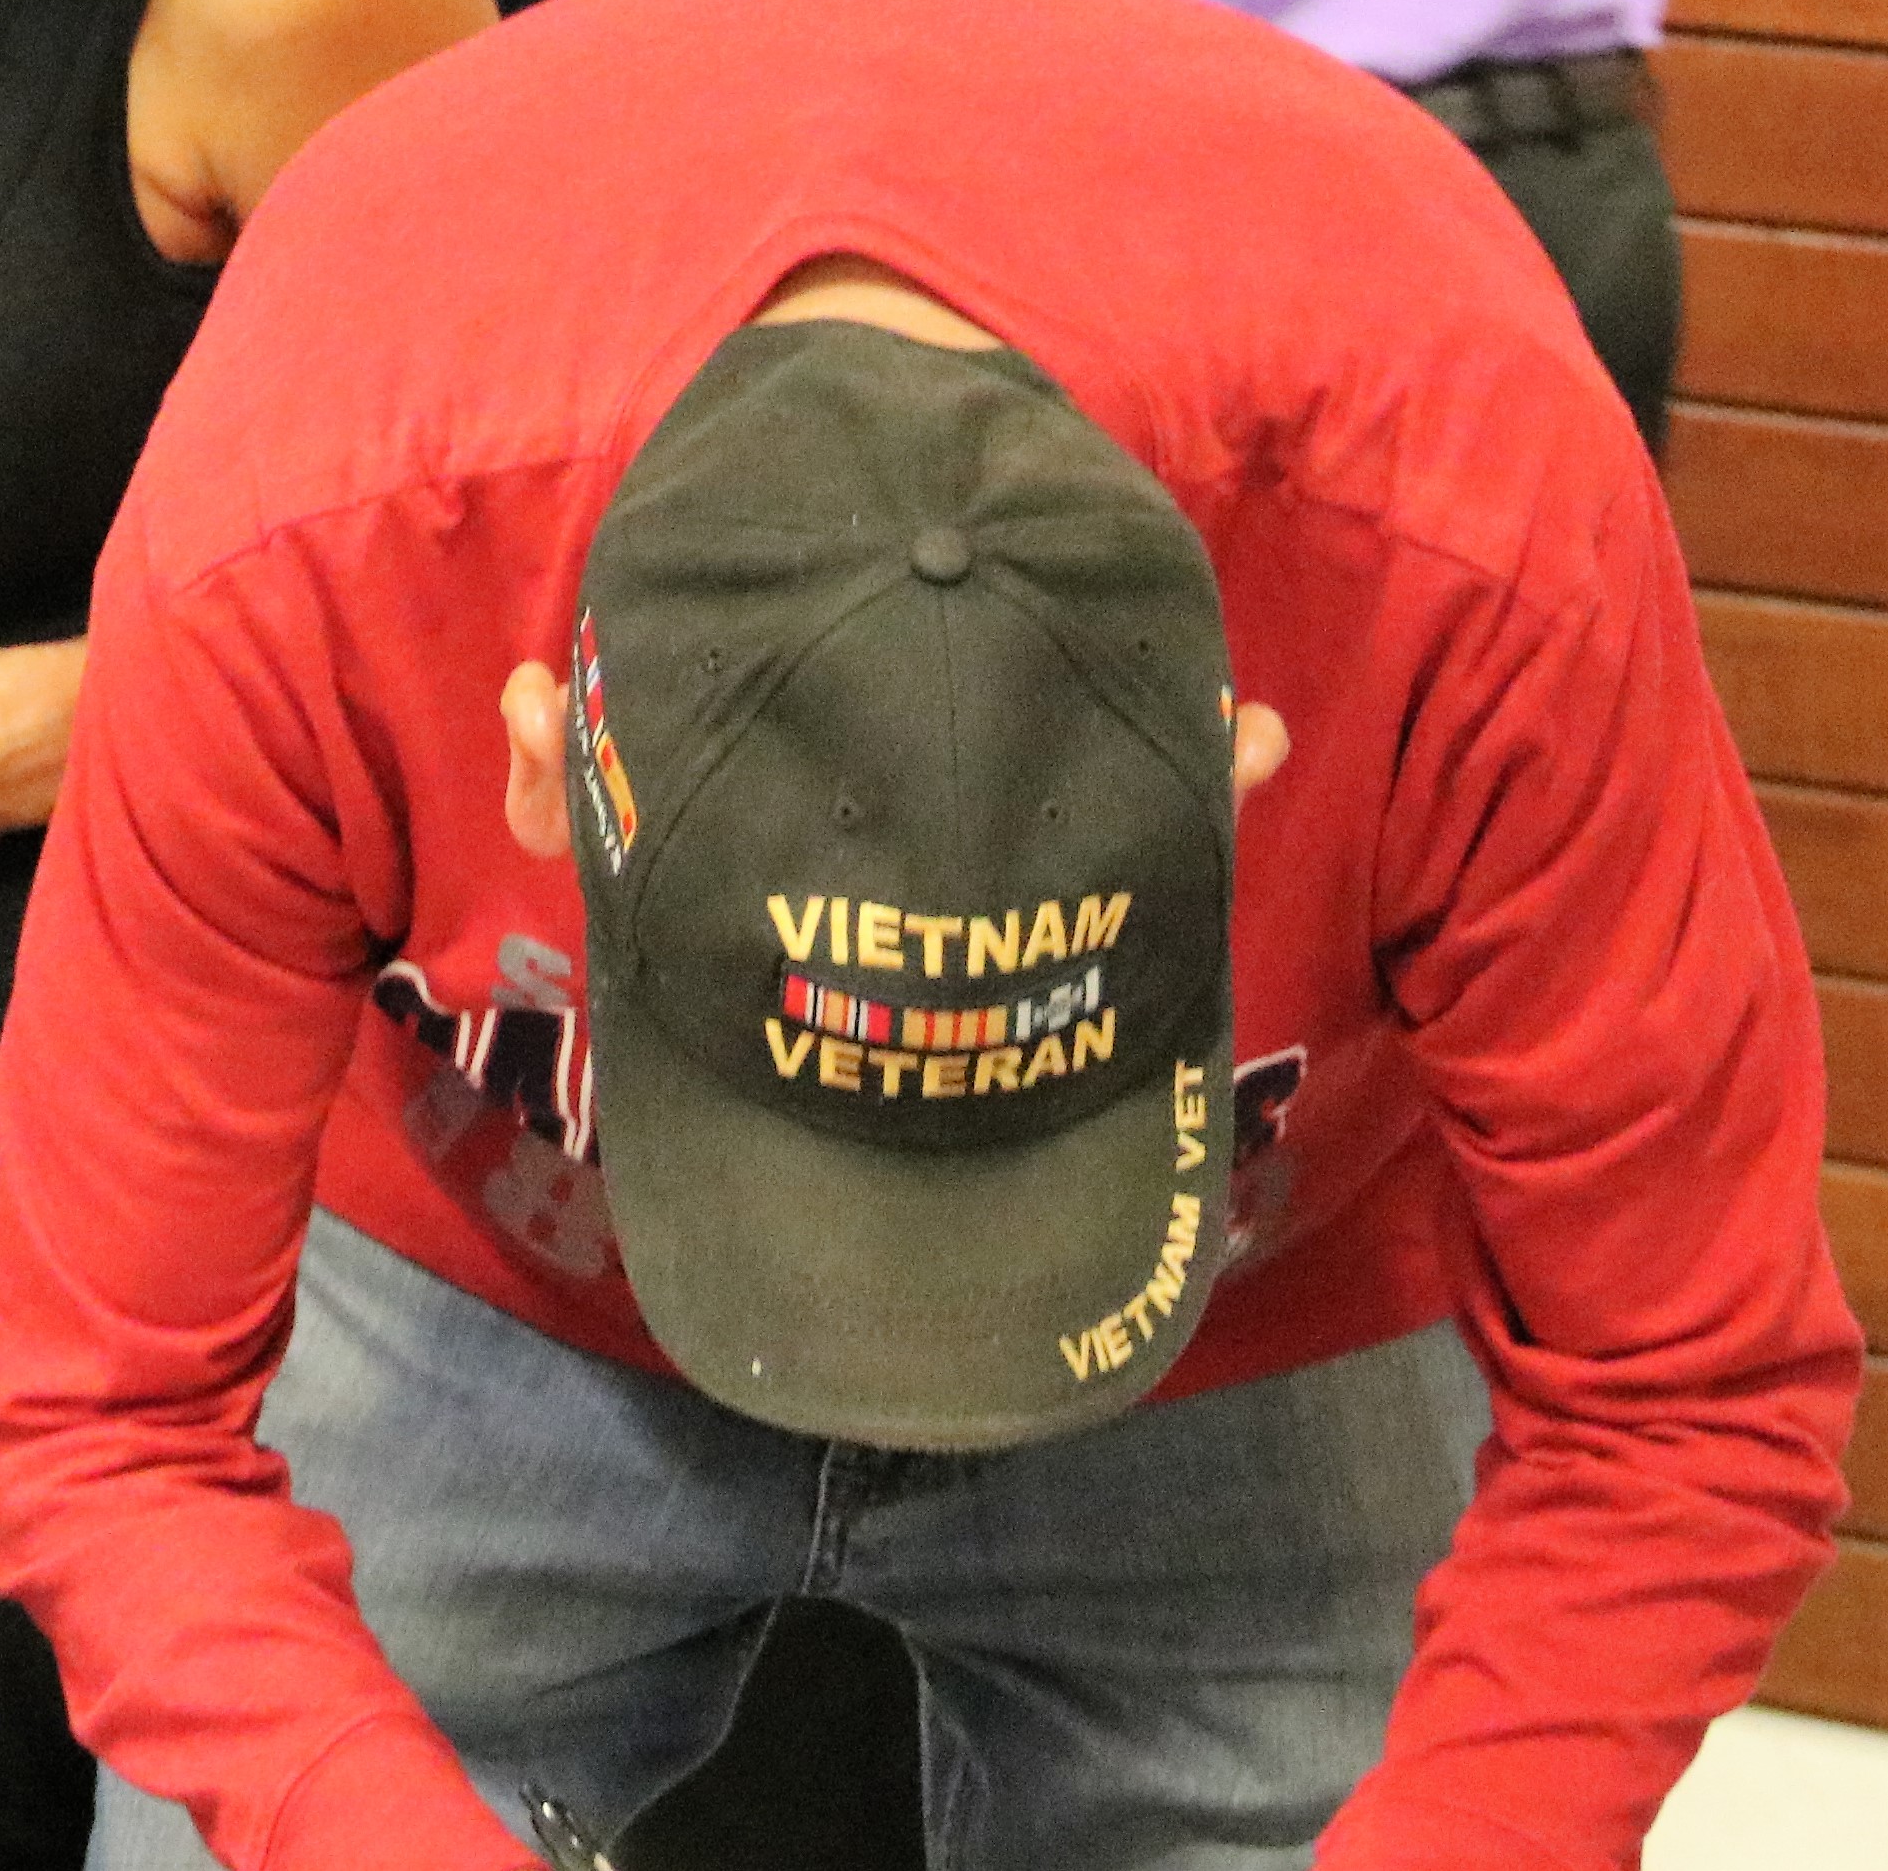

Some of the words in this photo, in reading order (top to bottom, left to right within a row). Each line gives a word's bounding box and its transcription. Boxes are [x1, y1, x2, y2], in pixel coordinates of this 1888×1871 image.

[766, 892, 1133, 979] VIETNAM
[765, 1006, 1117, 1099] VETERAN
[1058, 1192, 1202, 1382] VIETNAM
[1174, 1060, 1207, 1173] VET
